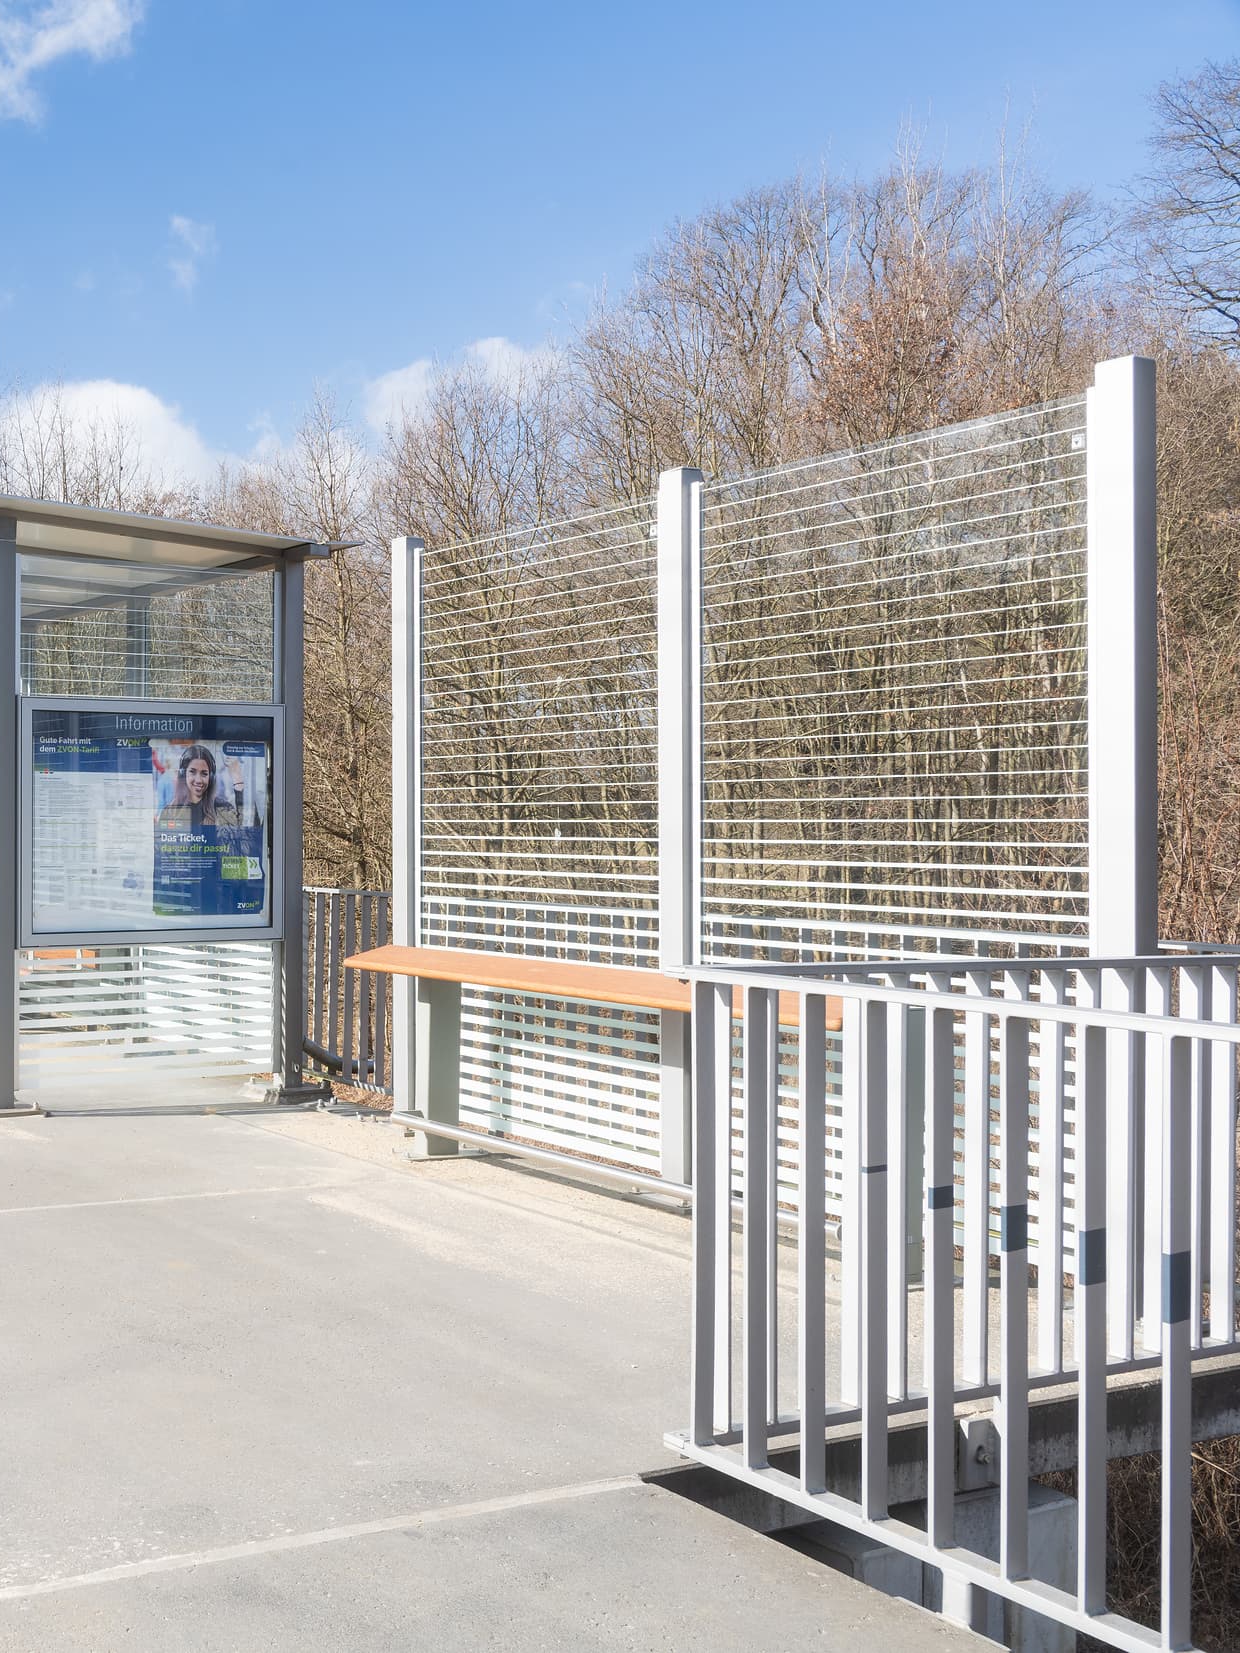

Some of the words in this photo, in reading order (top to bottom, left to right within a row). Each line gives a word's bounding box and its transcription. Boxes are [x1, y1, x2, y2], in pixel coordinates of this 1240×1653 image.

[115, 715, 193, 733] Information
[39, 736, 57, 744] Gute
[58, 736, 78, 745] Fahrt
[79, 737, 92, 745] mit
[39, 744, 56, 753] dem
[161, 833, 177, 842] Das
[178, 833, 207, 843] Ticket,
[190, 844, 203, 853] dir
